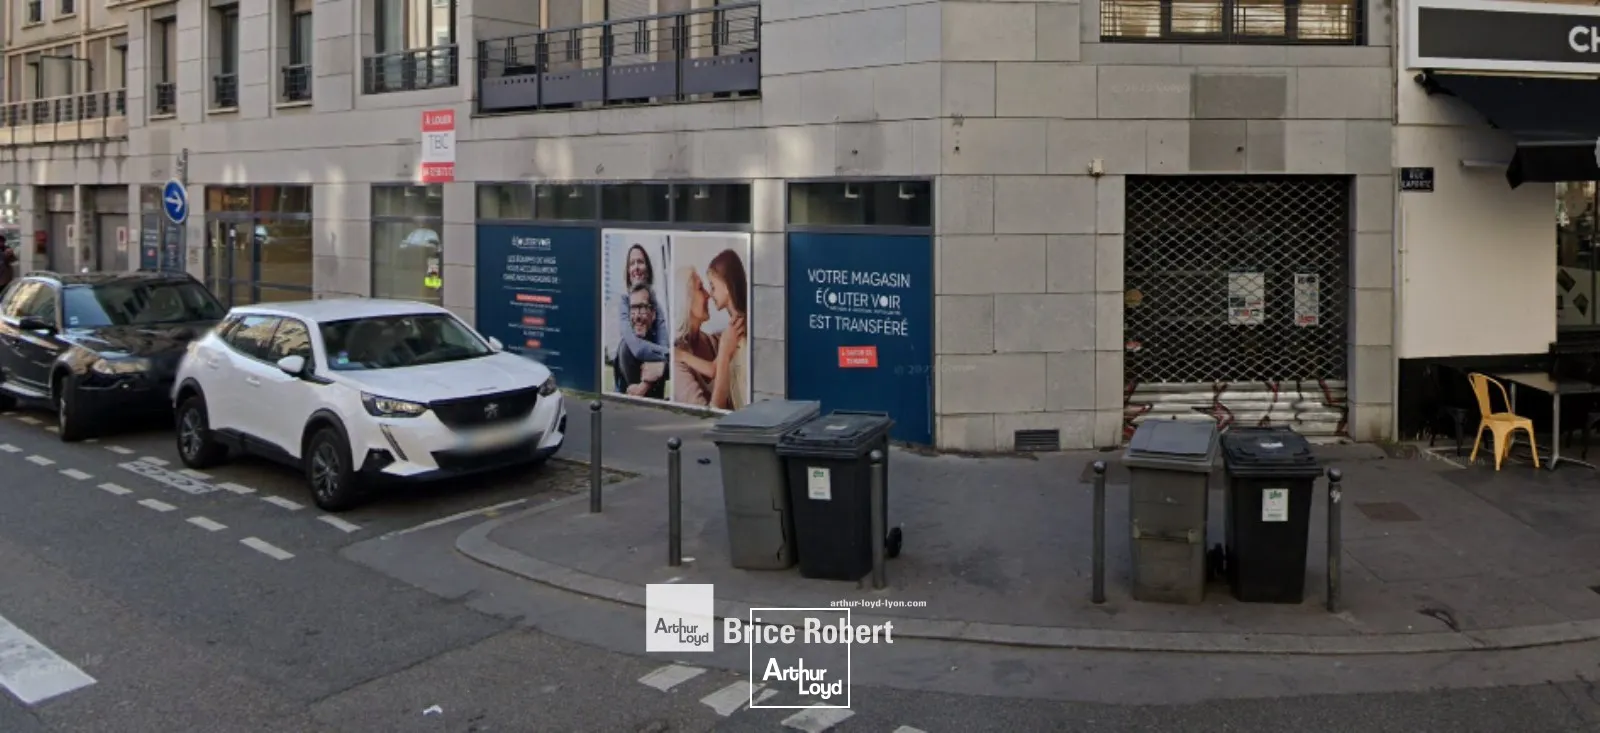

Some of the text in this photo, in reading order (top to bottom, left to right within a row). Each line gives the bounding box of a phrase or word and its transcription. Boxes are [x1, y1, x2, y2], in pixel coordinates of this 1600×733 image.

[807, 267, 911, 289] VOTRE MAGASIN
[816, 287, 901, 309] ÉCOUTER VOIR
[809, 313, 909, 336] EST TRANSFÉRÉ
